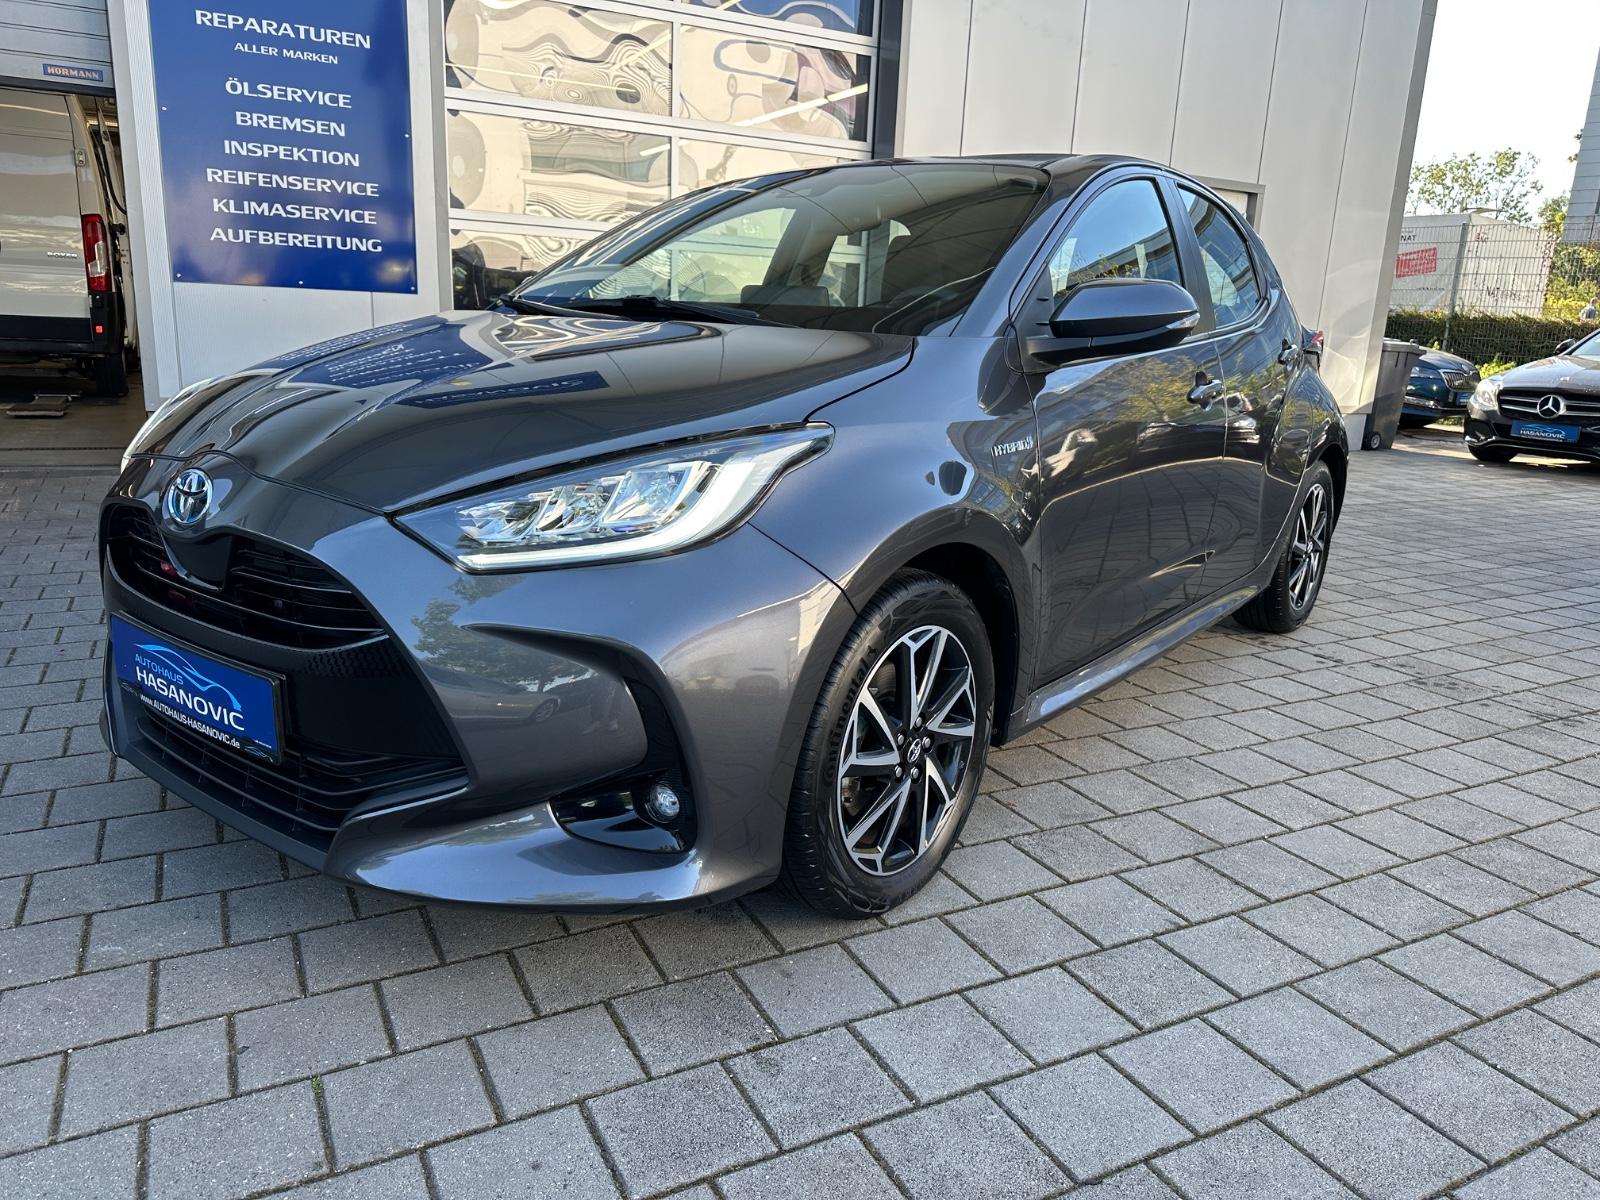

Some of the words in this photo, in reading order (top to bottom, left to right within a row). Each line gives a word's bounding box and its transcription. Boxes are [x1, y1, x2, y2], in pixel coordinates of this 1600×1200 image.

[195, 9, 371, 49] REPARATUREN
[234, 42, 278, 56] ALLER
[282, 48, 338, 64] MARKEN
[225, 77, 352, 108] ÖLSERVICE
[235, 111, 346, 137] BREMSEN
[224, 140, 360, 167] INSPEKTION
[206, 167, 379, 196] REIFENSERVICE
[212, 198, 377, 224] KLIMASERVICE
[209, 228, 383, 252] AUFBEREITUNG
[1520, 430, 1566, 439] HASANOVIC
[993, 439, 1029, 457] HYBRID
[135, 653, 184, 685] AUTOHAUS
[135, 666, 245, 731] HASANOVIC
